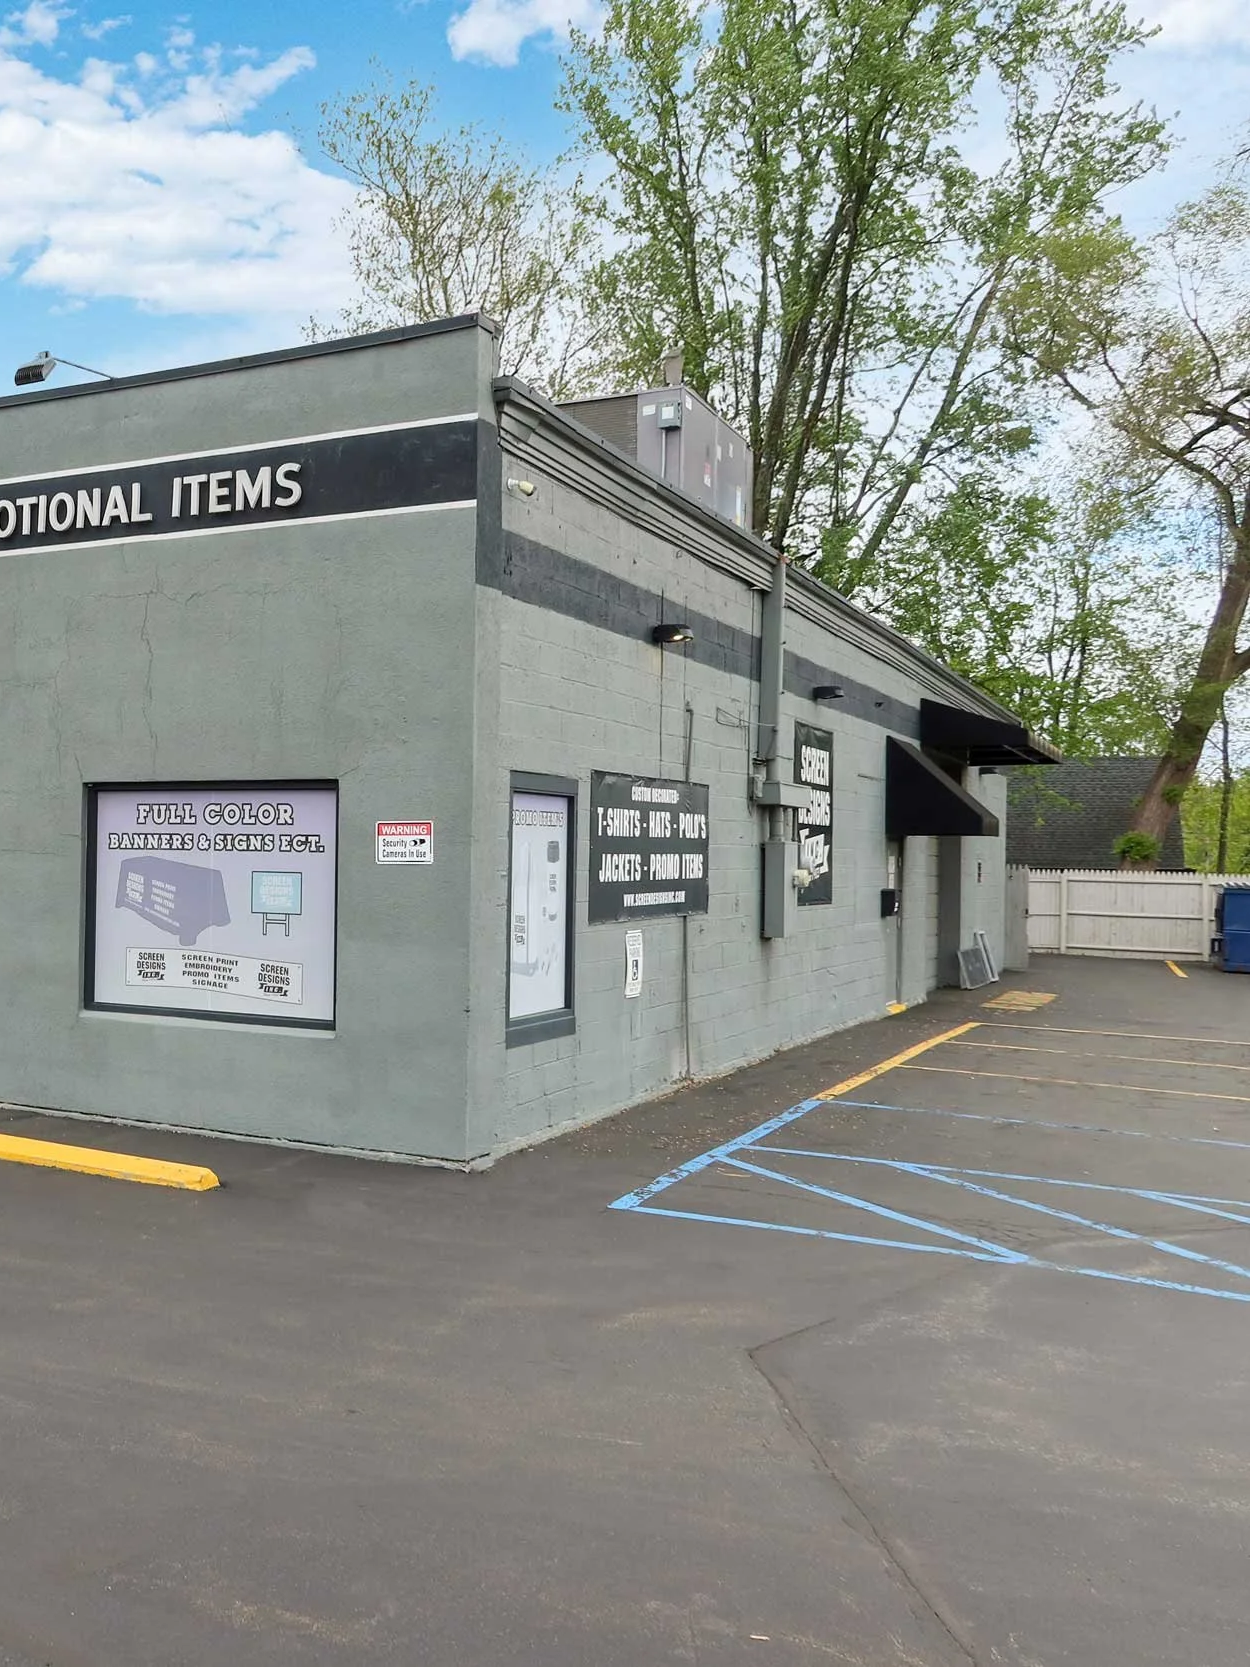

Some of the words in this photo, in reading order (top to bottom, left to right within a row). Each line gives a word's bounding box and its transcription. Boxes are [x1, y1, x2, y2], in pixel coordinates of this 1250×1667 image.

[172, 463, 302, 518] ITEMS
[800, 744, 830, 786] SCREEN
[136, 803, 197, 825] FULL
[203, 803, 295, 826] COLOR
[597, 806, 641, 837] T-SHIRTS
[649, 810, 671, 838] HATS
[679, 812, 706, 839] POLO'S
[381, 825, 428, 835] WARNING
[108, 832, 194, 850] BANNERS
[197, 834, 211, 850] &
[214, 833, 275, 851] SIGNS
[279, 834, 325, 853] ECT.
[382, 838, 408, 848] Security
[382, 849, 407, 858] Cameras
[409, 849, 414, 858] In
[416, 849, 427, 858] Use
[599, 853, 642, 883] JACKETS
[650, 853, 680, 881] PROMO
[681, 853, 704, 880] ITEMS
[138, 952, 165, 962] SCREEN
[181, 954, 214, 963] SCREEN
[216, 957, 239, 967] PRINT
[136, 961, 166, 970] DESIGNS
[184, 962, 233, 974] EMBROIDERY
[260, 963, 289, 976] SCREEN
[182, 970, 210, 978] PROMO
[213, 973, 240, 983] ITEMS
[258, 972, 291, 986] DESIGNS
[192, 979, 228, 989] SIGNAGE
